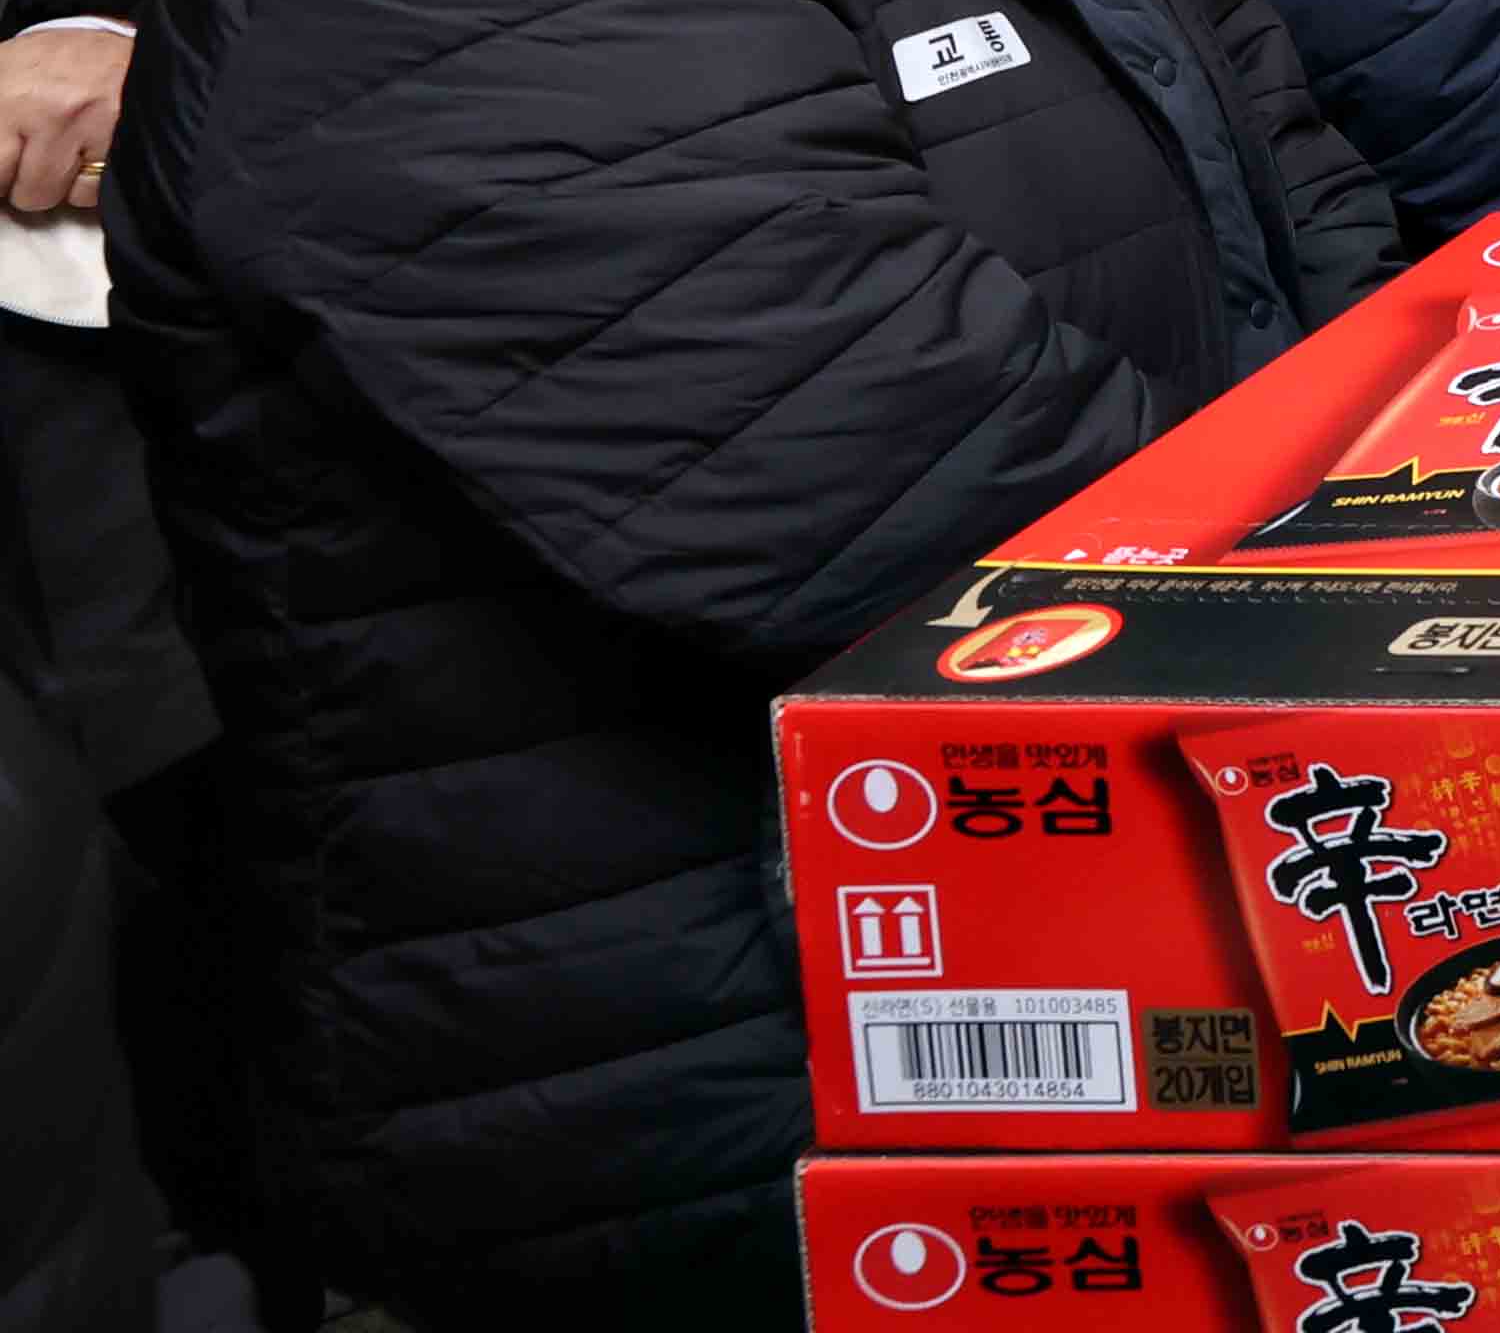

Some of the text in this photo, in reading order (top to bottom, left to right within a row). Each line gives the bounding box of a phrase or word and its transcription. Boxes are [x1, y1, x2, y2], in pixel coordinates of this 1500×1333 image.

[928, 32, 965, 71] 교
[1331, 487, 1468, 509] SHIN RAMYUN
[941, 742, 1108, 771] 인생을 맛있게
[945, 776, 1113, 840] 농심
[1264, 763, 1449, 995] 辛
[1014, 997, 1119, 1016] 101003485
[1151, 1011, 1254, 1055] 봉지면
[1154, 1060, 1256, 1107] 20개입
[1313, 1056, 1344, 1075] SHIN
[912, 1078, 1087, 1101] 8801043014854
[973, 1235, 1144, 1296] 농심
